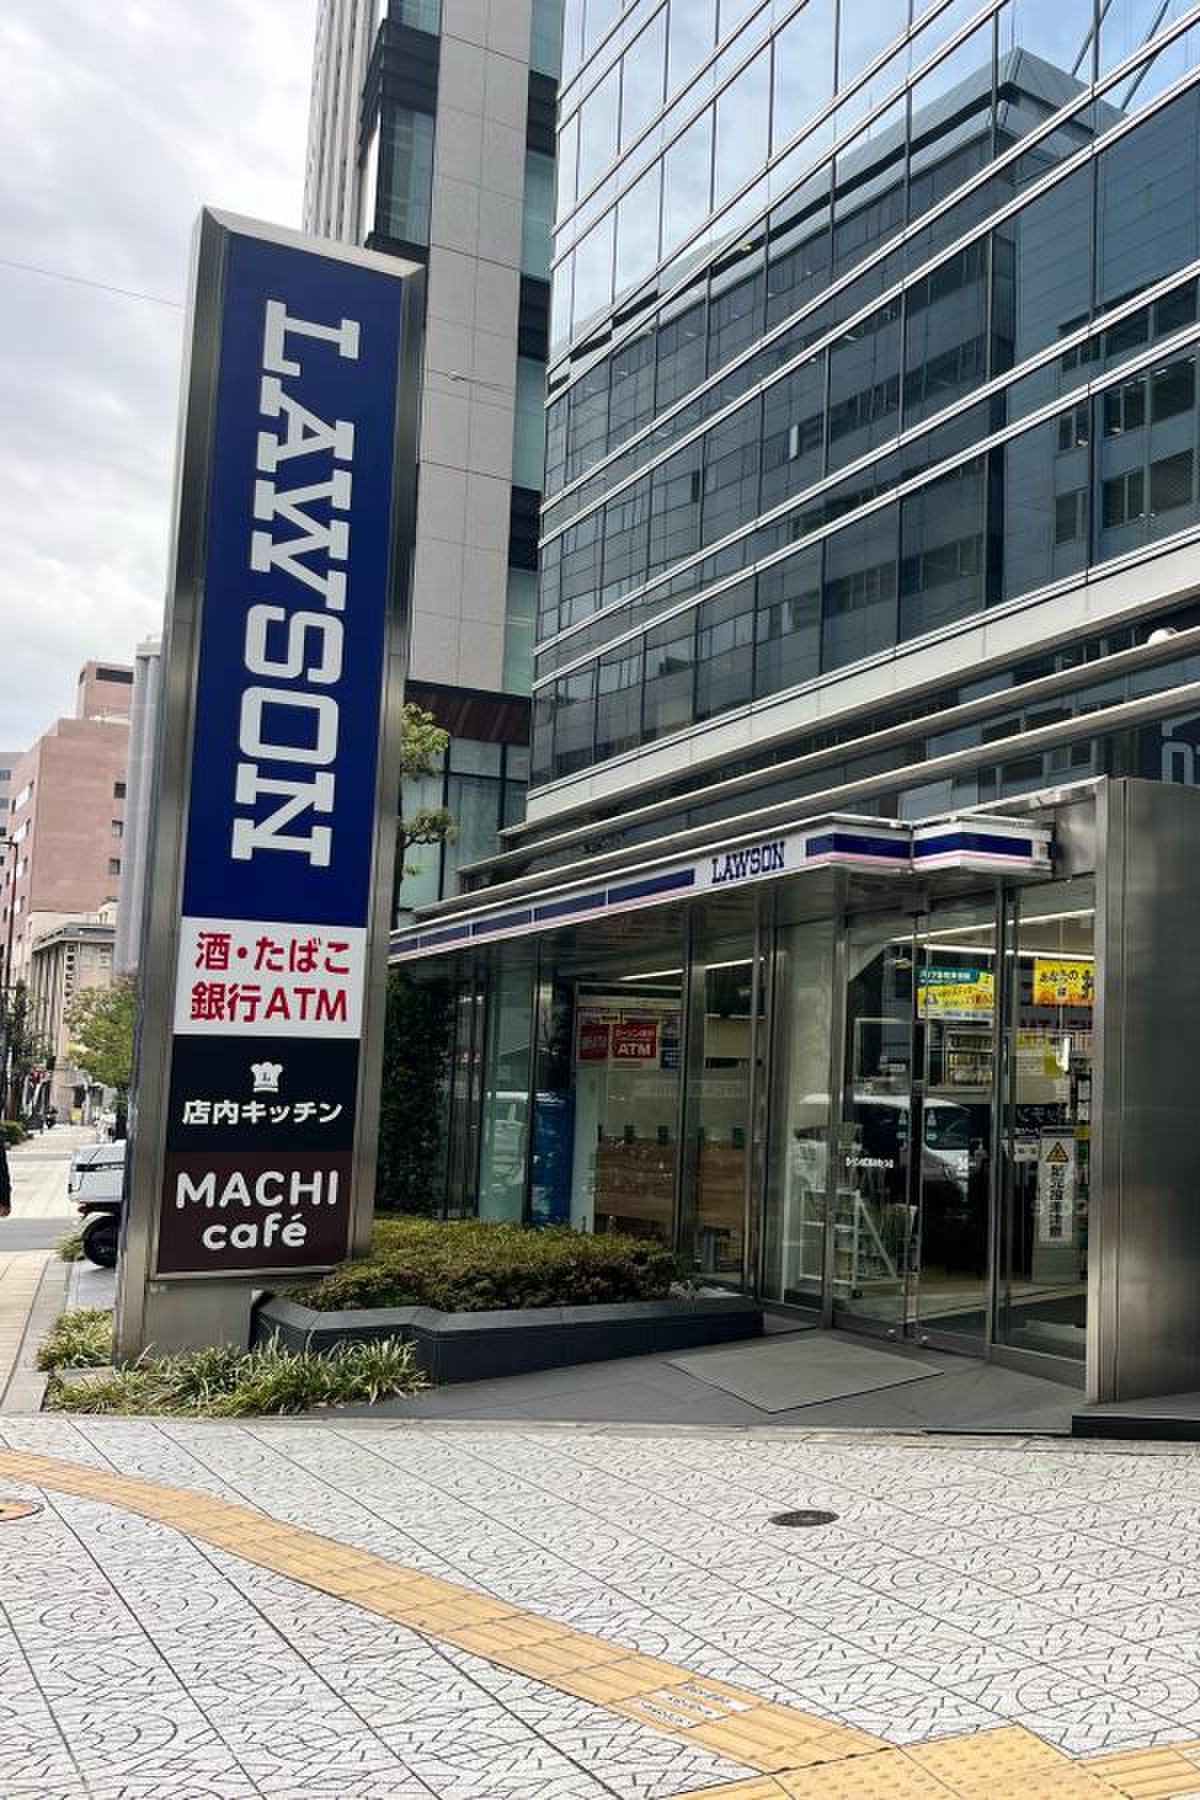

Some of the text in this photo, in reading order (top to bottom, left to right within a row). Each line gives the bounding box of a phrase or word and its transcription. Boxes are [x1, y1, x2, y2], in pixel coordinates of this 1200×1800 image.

[231, 299, 361, 868] LAWSON
[711, 841, 785, 884] LAWSON
[195, 931, 350, 975] 酒・たばこ
[190, 981, 347, 1022] 銀行ATM
[617, 1043, 651, 1056] ATM
[182, 1100, 343, 1125] 店内キッチン
[176, 1170, 338, 1209] MACHI
[202, 1212, 307, 1250] café
